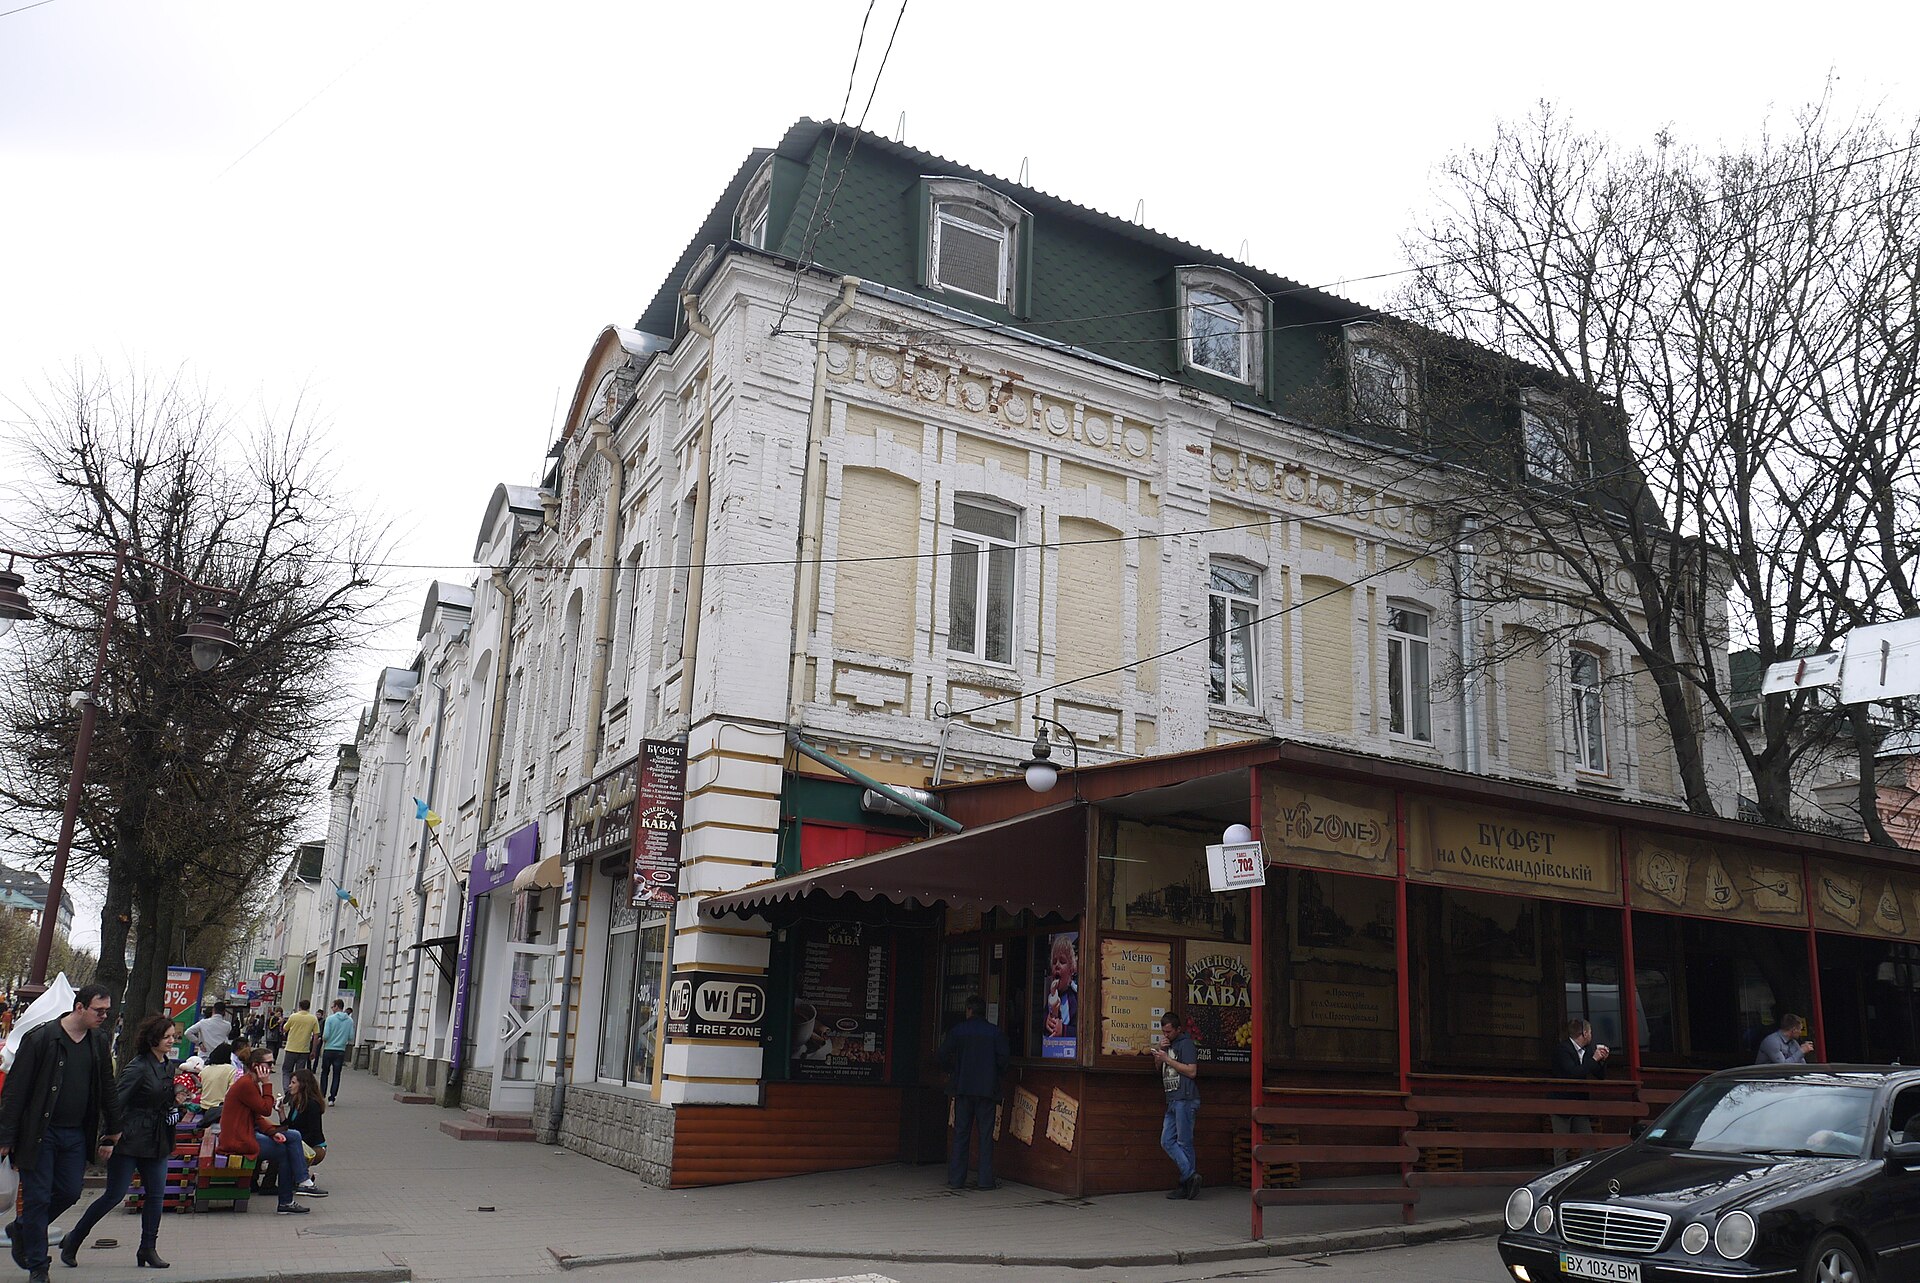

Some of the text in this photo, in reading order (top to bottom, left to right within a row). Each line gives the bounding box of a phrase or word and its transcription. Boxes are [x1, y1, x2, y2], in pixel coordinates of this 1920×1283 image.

[641, 817, 677, 831] КАВА
[1437, 848, 1456, 863] на
[1237, 858, 1254, 872] 702
[827, 932, 861, 946] КАВА
[1121, 950, 1153, 963] Меню
[1111, 962, 1126, 972] Чай
[1186, 955, 1252, 984] ВІДЕНСЬКА
[1111, 976, 1129, 985] Кава
[1187, 983, 1252, 1008] КАВА
[1111, 1006, 1131, 1015] Пиво
[695, 1024, 762, 1037] FREE ZONE
[1111, 1020, 1148, 1030] Кока-кола
[1111, 1033, 1128, 1043] Квас
[1566, 1256, 1638, 1281] BX 1034 BM
